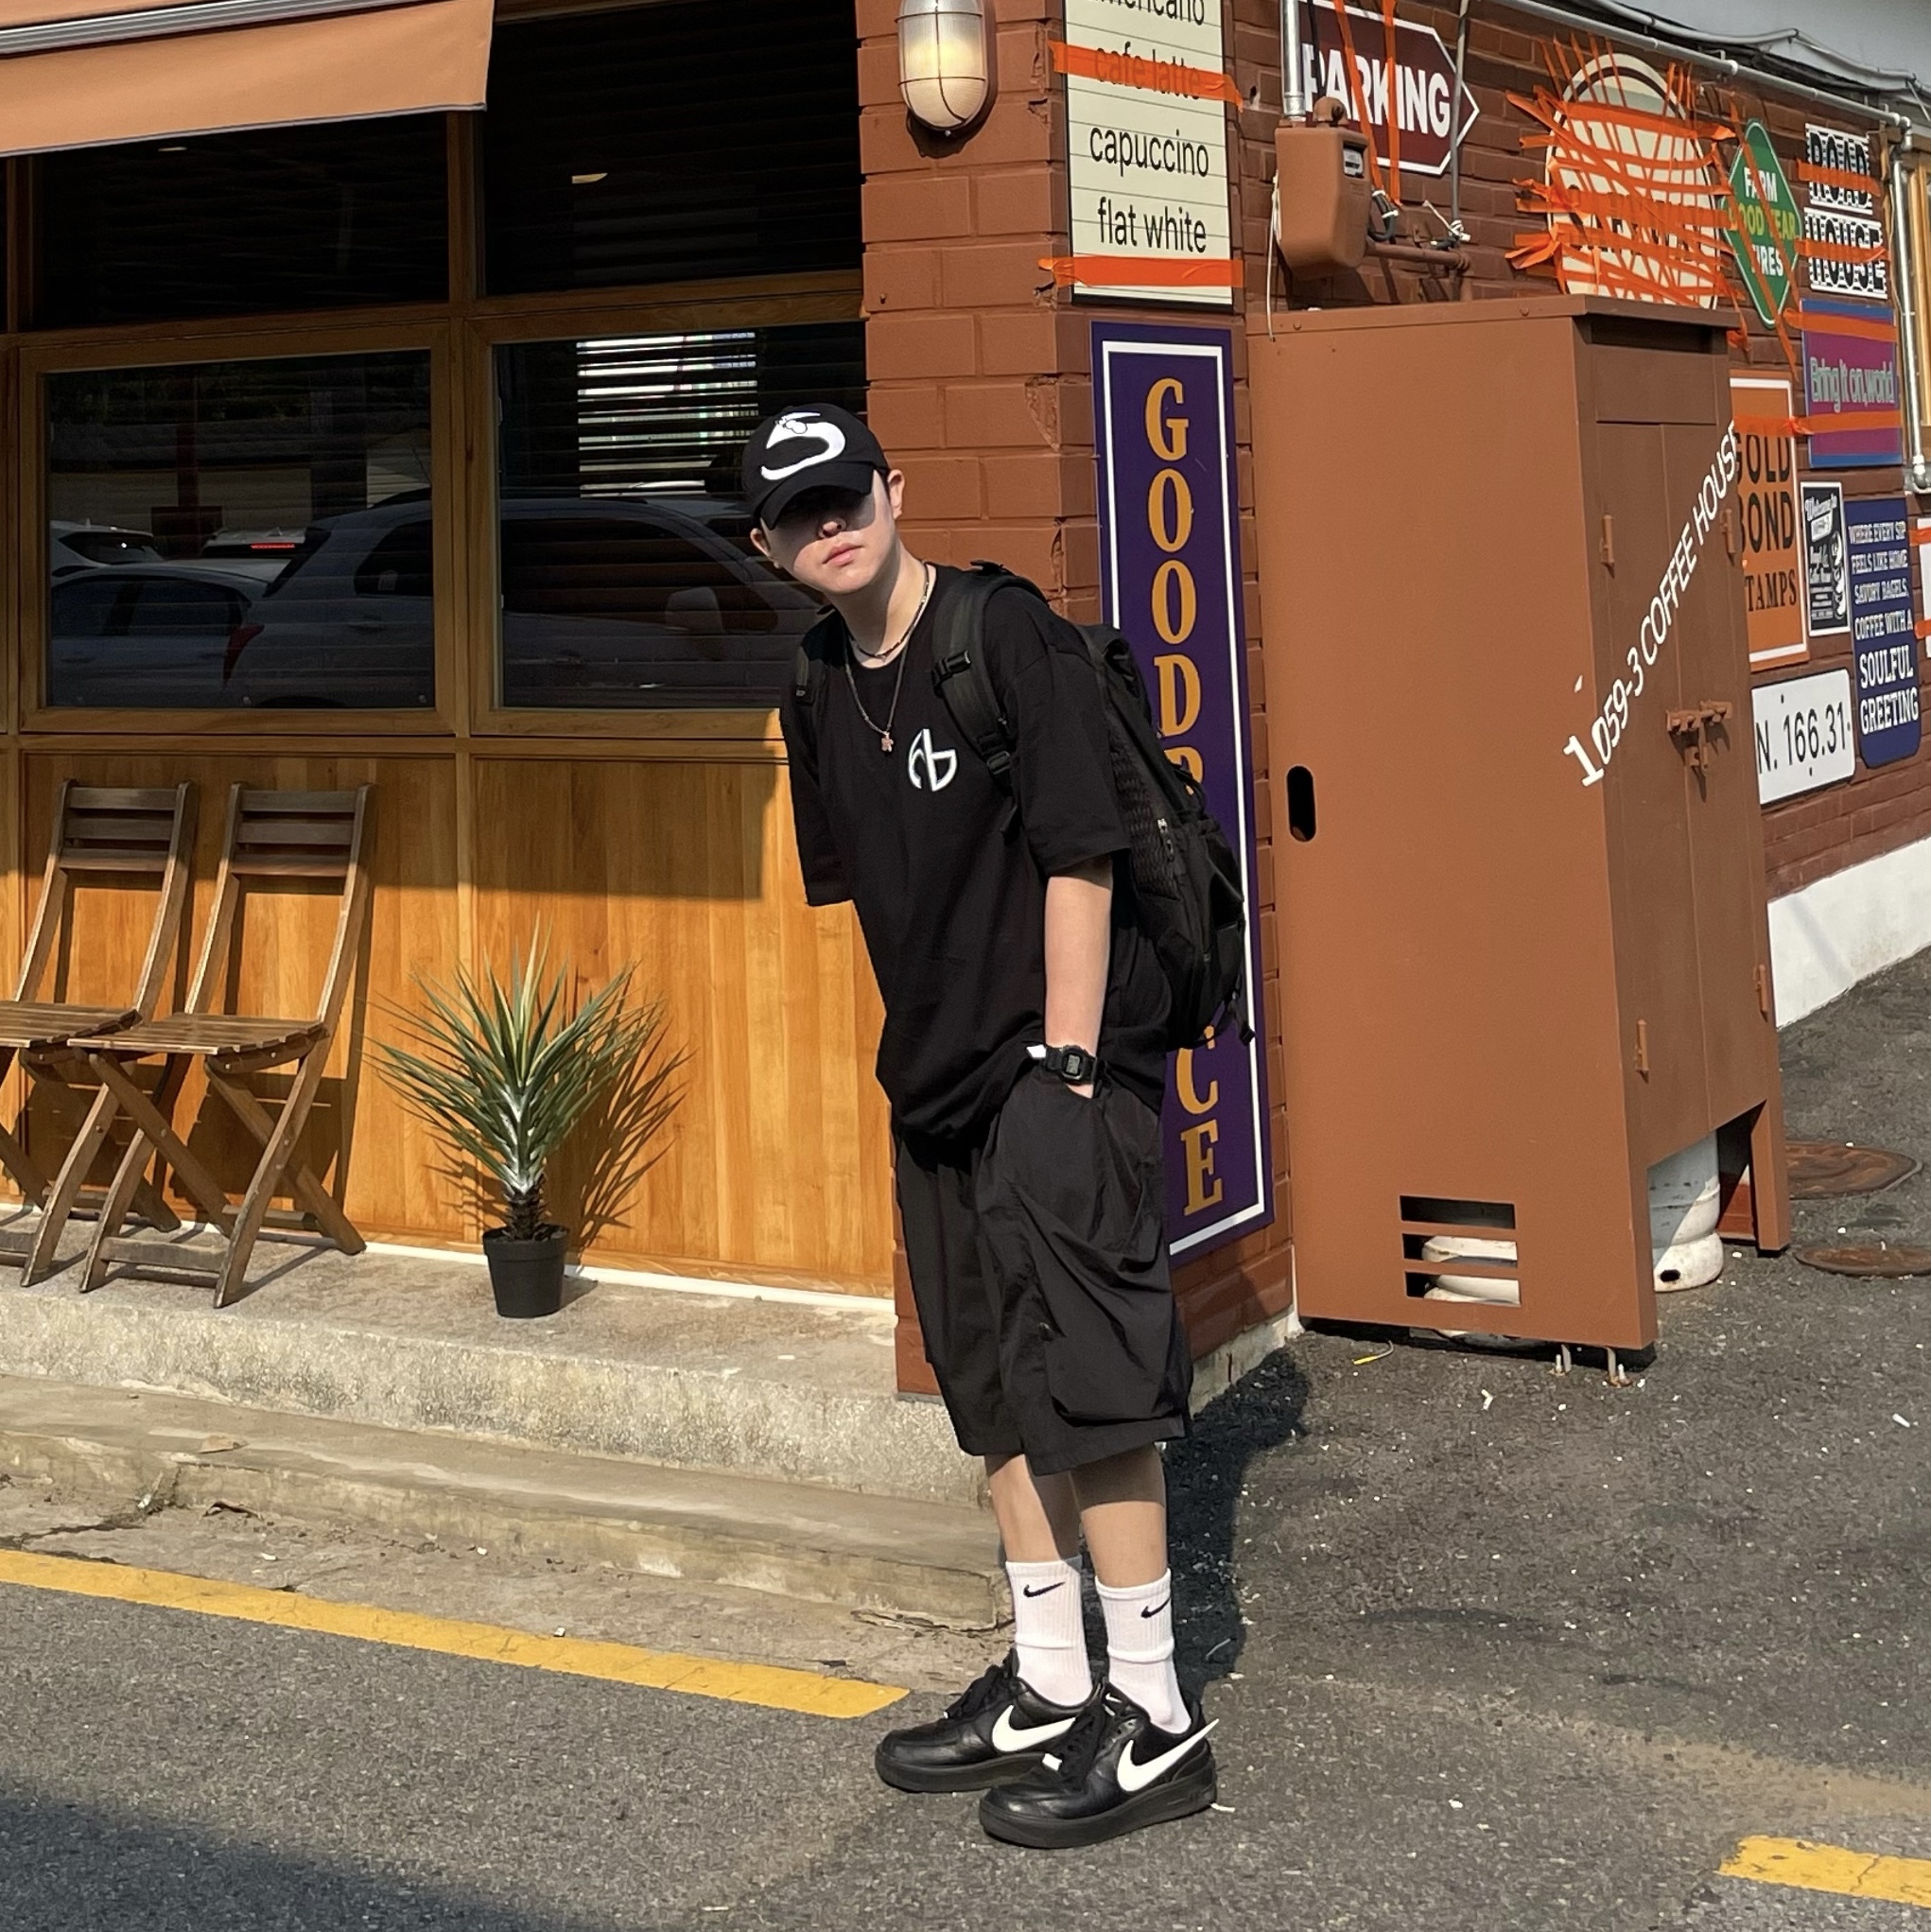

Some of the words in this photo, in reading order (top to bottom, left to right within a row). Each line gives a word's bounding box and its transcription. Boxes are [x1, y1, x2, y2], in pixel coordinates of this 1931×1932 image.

[1152, 48, 1201, 99] latte
[1302, 43, 1451, 138] PARKING
[1089, 128, 1209, 178] capuccino
[1097, 196, 1138, 247] flat
[1143, 205, 1207, 253] white
[1751, 243, 1784, 277] IRES
[1738, 491, 1795, 554] OND
[1641, 521, 1697, 666] COFFEE
[1742, 568, 1797, 612] TAMPS
[1859, 644, 1914, 689] SOULFUL
[1783, 701, 1846, 764] 166.31
[1860, 687, 1919, 735] GREETING
